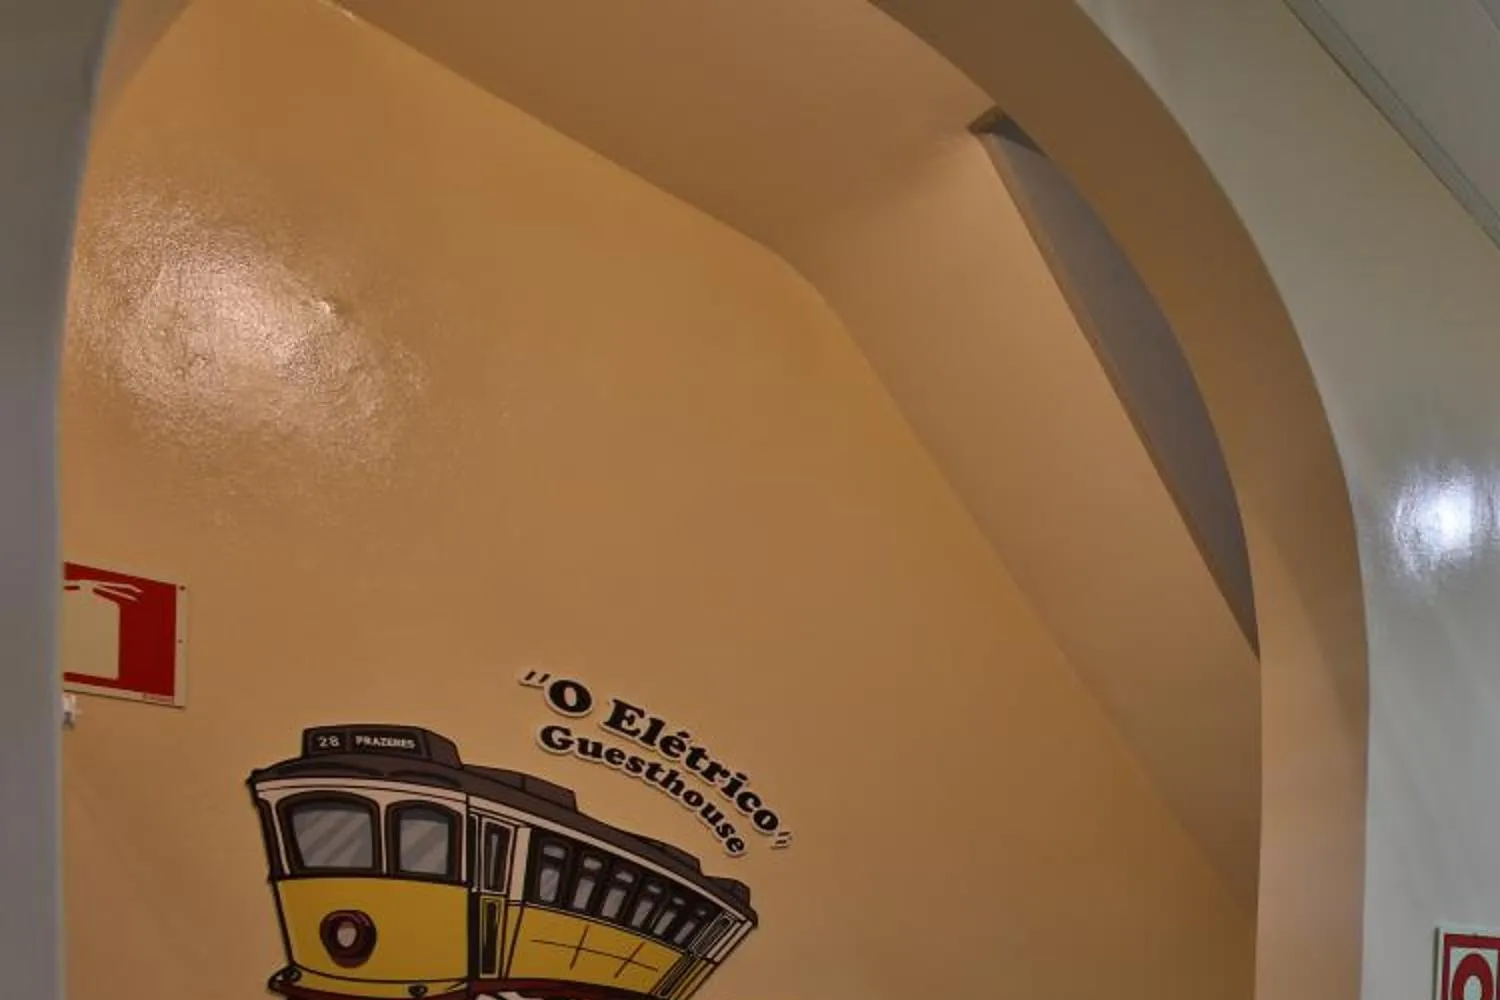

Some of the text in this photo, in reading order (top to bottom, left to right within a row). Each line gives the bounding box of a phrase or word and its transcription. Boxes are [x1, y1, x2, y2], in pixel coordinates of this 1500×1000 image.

[319, 735, 341, 748] 28
[355, 735, 416, 750] PRAZERES
[539, 724, 745, 854] Guesthouse
